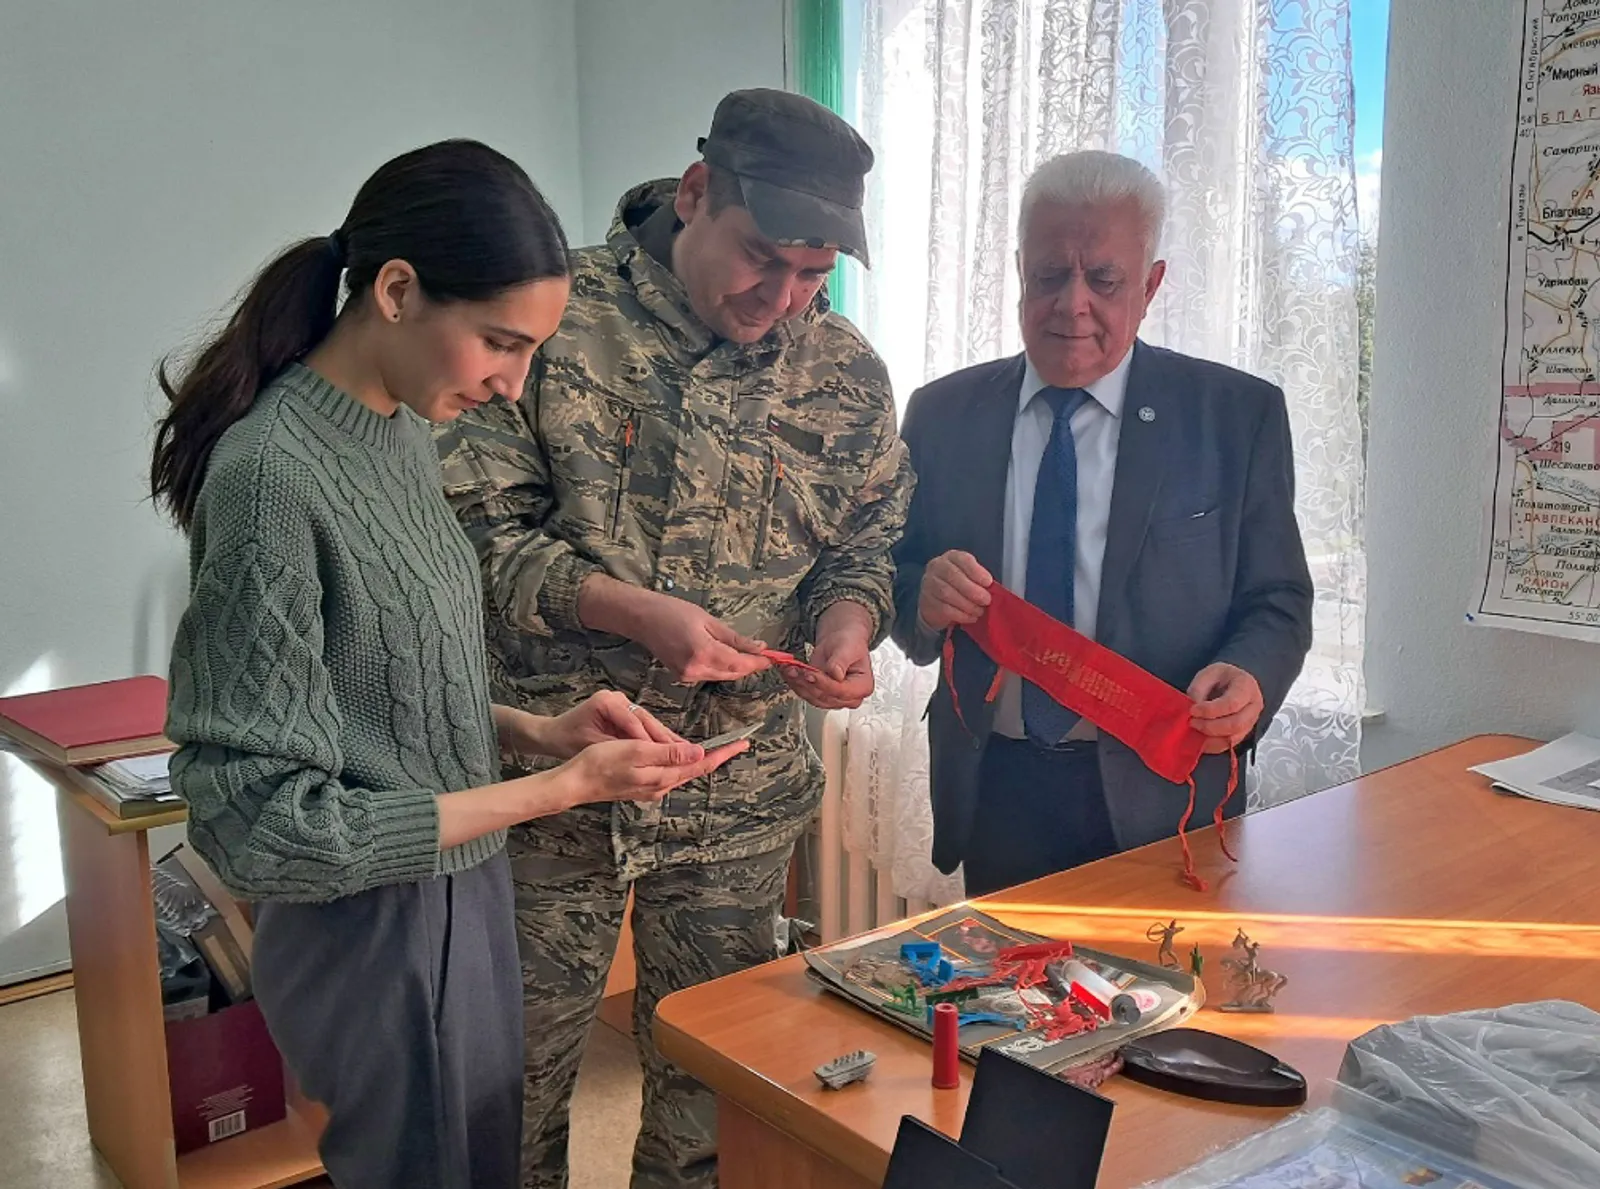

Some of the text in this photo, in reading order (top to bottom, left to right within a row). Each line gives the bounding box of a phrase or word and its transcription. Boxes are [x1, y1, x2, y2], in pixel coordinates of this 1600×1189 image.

[1552, 63, 1598, 80] Мирный
[1542, 205, 1594, 220] Благовар
[1523, 577, 1569, 591] РАЙОН
